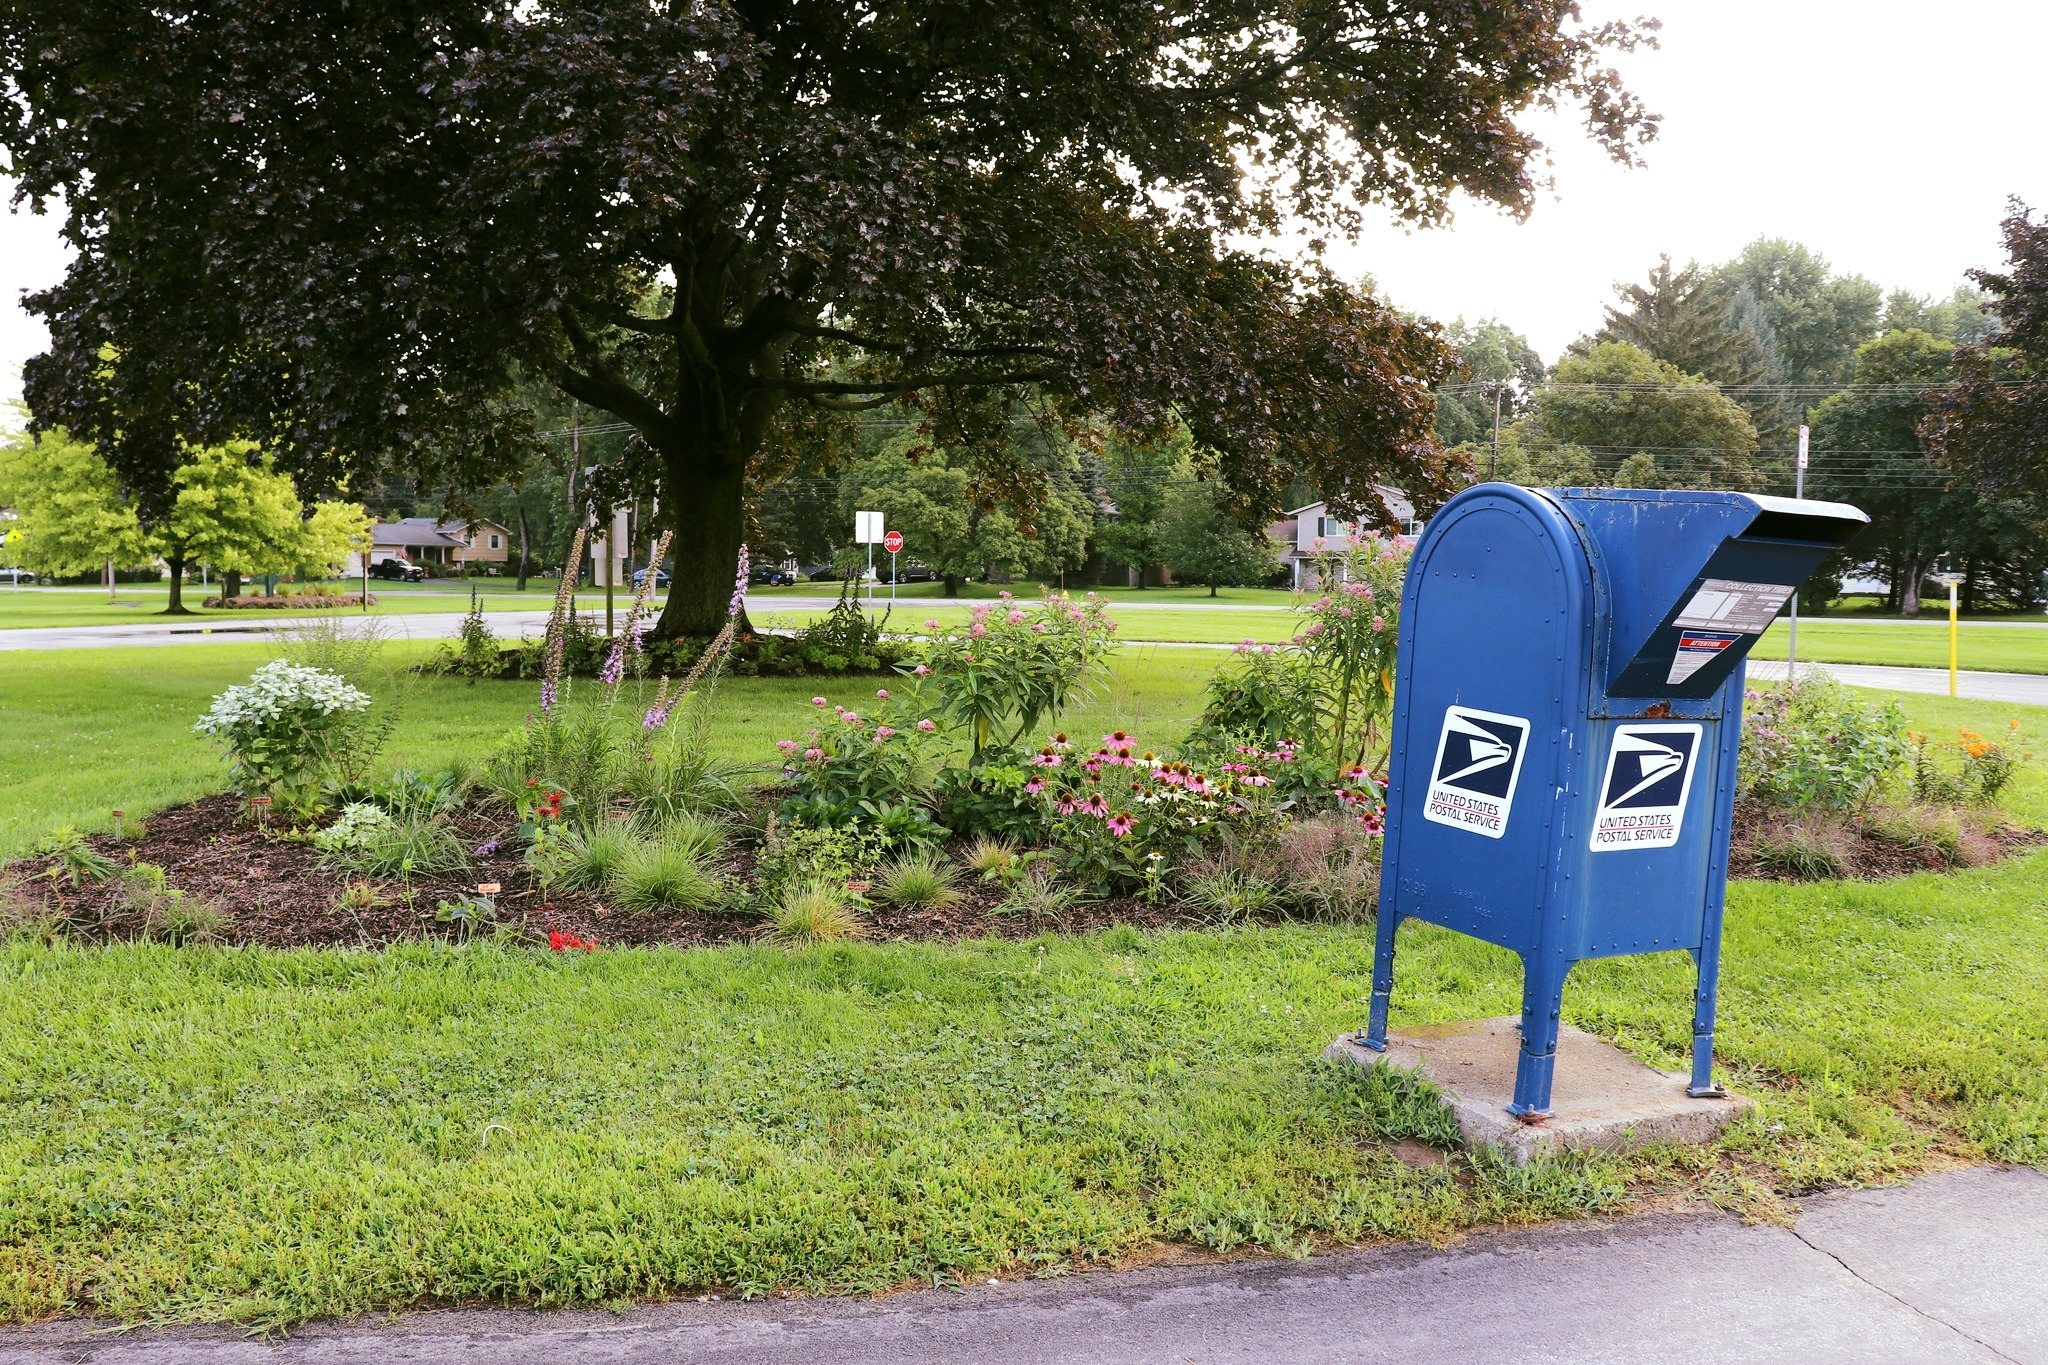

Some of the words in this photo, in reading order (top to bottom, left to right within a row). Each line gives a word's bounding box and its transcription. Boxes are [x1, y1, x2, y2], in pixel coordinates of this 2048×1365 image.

[886, 538, 902, 546] STOP
[1725, 582, 1771, 593] COLLECTION
[1770, 586, 1795, 594] TIMES
[1689, 640, 1721, 648] ATTENTION
[1432, 790, 1467, 807] UNITED
[1467, 798, 1499, 815] STATES
[1430, 802, 1462, 821] POSTAL
[1463, 812, 1500, 830] SERVICE
[1600, 816, 1637, 828] UNITED
[1638, 814, 1672, 825] STATES
[1596, 830, 1632, 843] POSTAL
[1634, 828, 1673, 841] SERVICE
